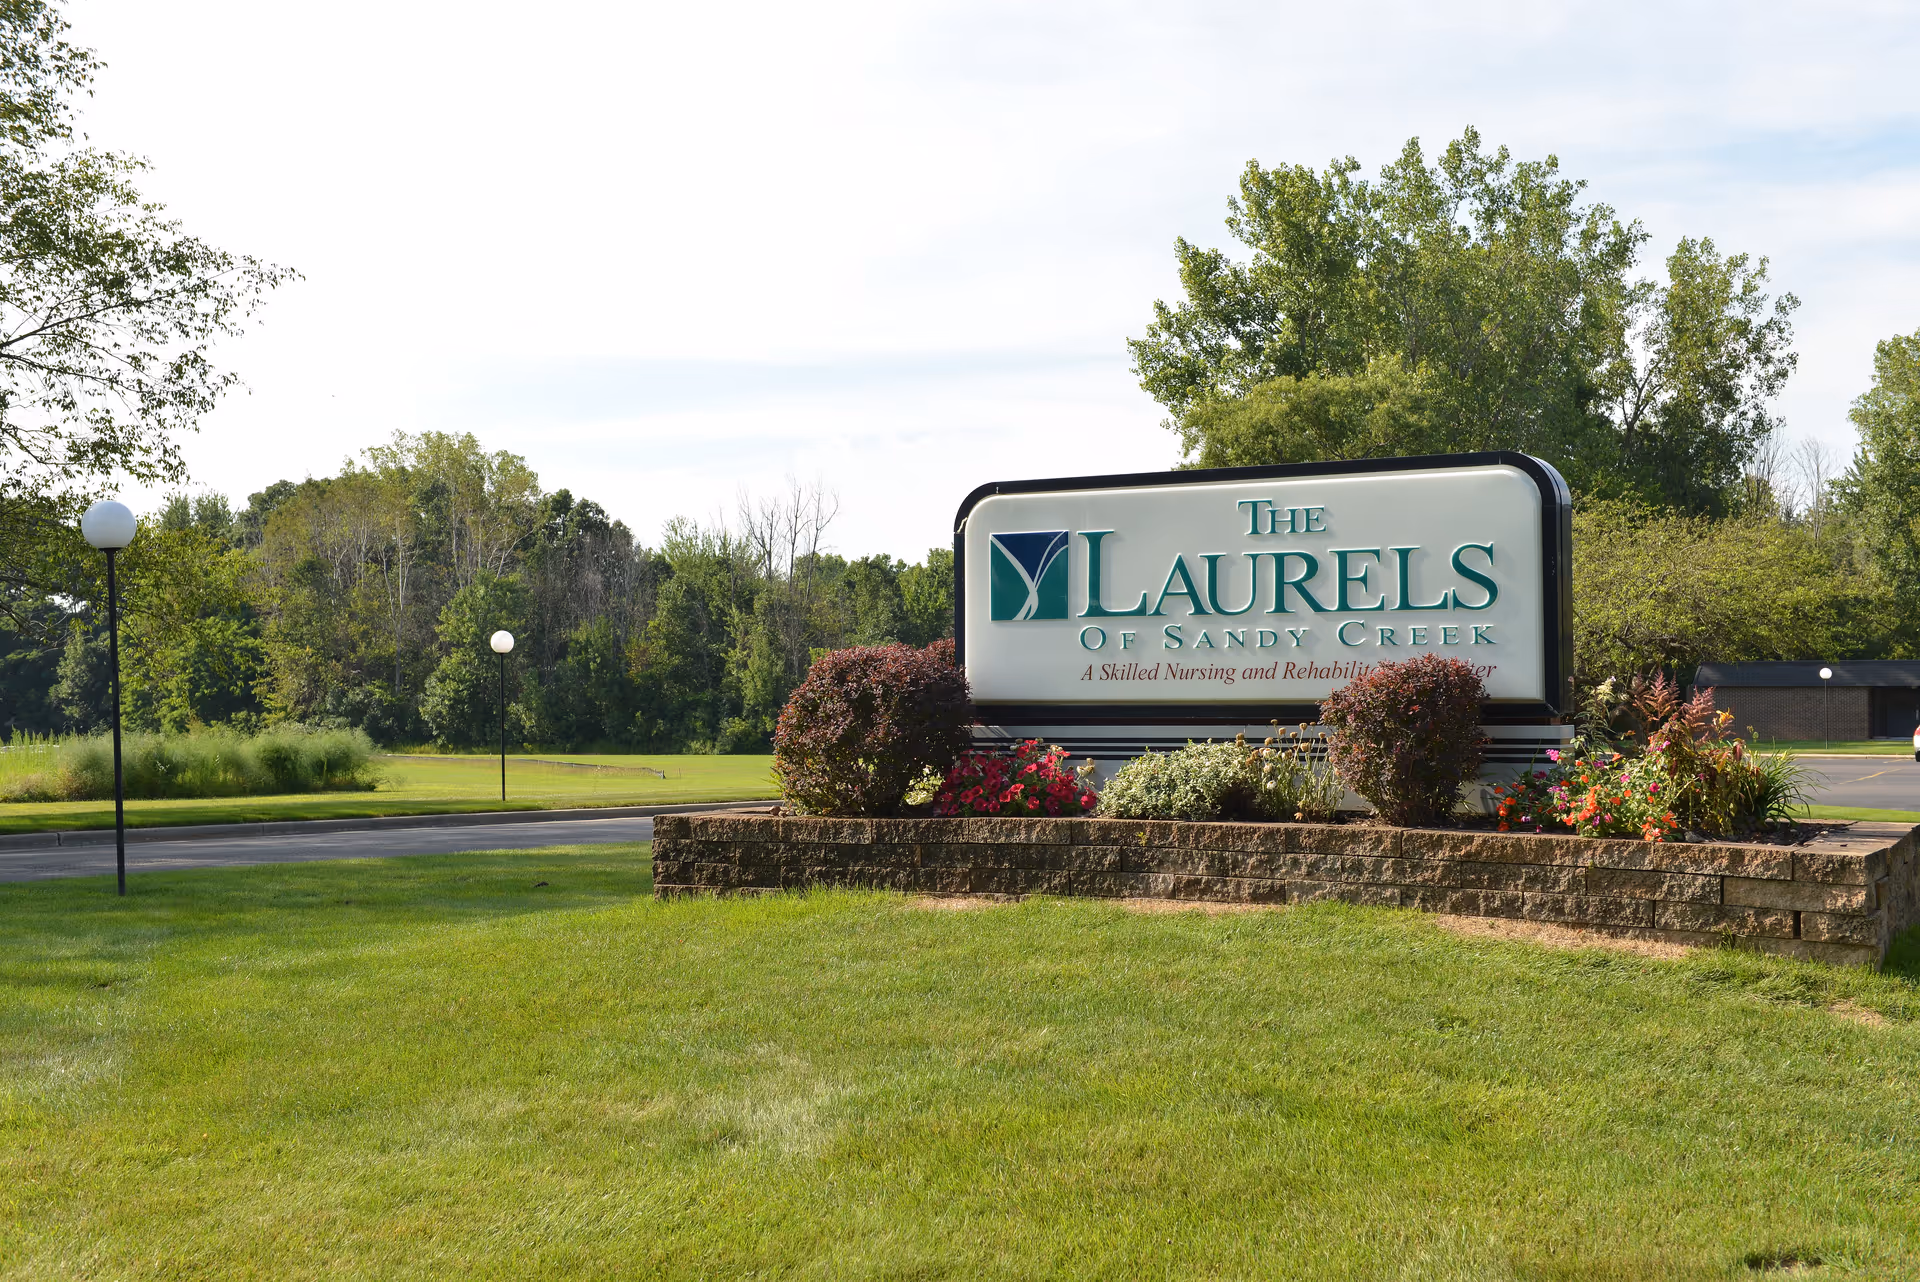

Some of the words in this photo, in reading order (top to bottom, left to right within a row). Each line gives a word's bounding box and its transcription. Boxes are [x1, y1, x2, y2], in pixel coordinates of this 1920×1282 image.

[1237, 499, 1327, 535] THE
[1077, 529, 1499, 617] LAURELS
[1079, 625, 1136, 650] OF
[1162, 623, 1308, 650] SANDY
[1336, 620, 1497, 647] CREEK
[1080, 663, 1094, 681] A
[1099, 662, 1161, 681] Skilled
[1163, 662, 1237, 685] Nursing
[1242, 661, 1278, 680] and
[1281, 660, 1395, 680] Rehabilit
